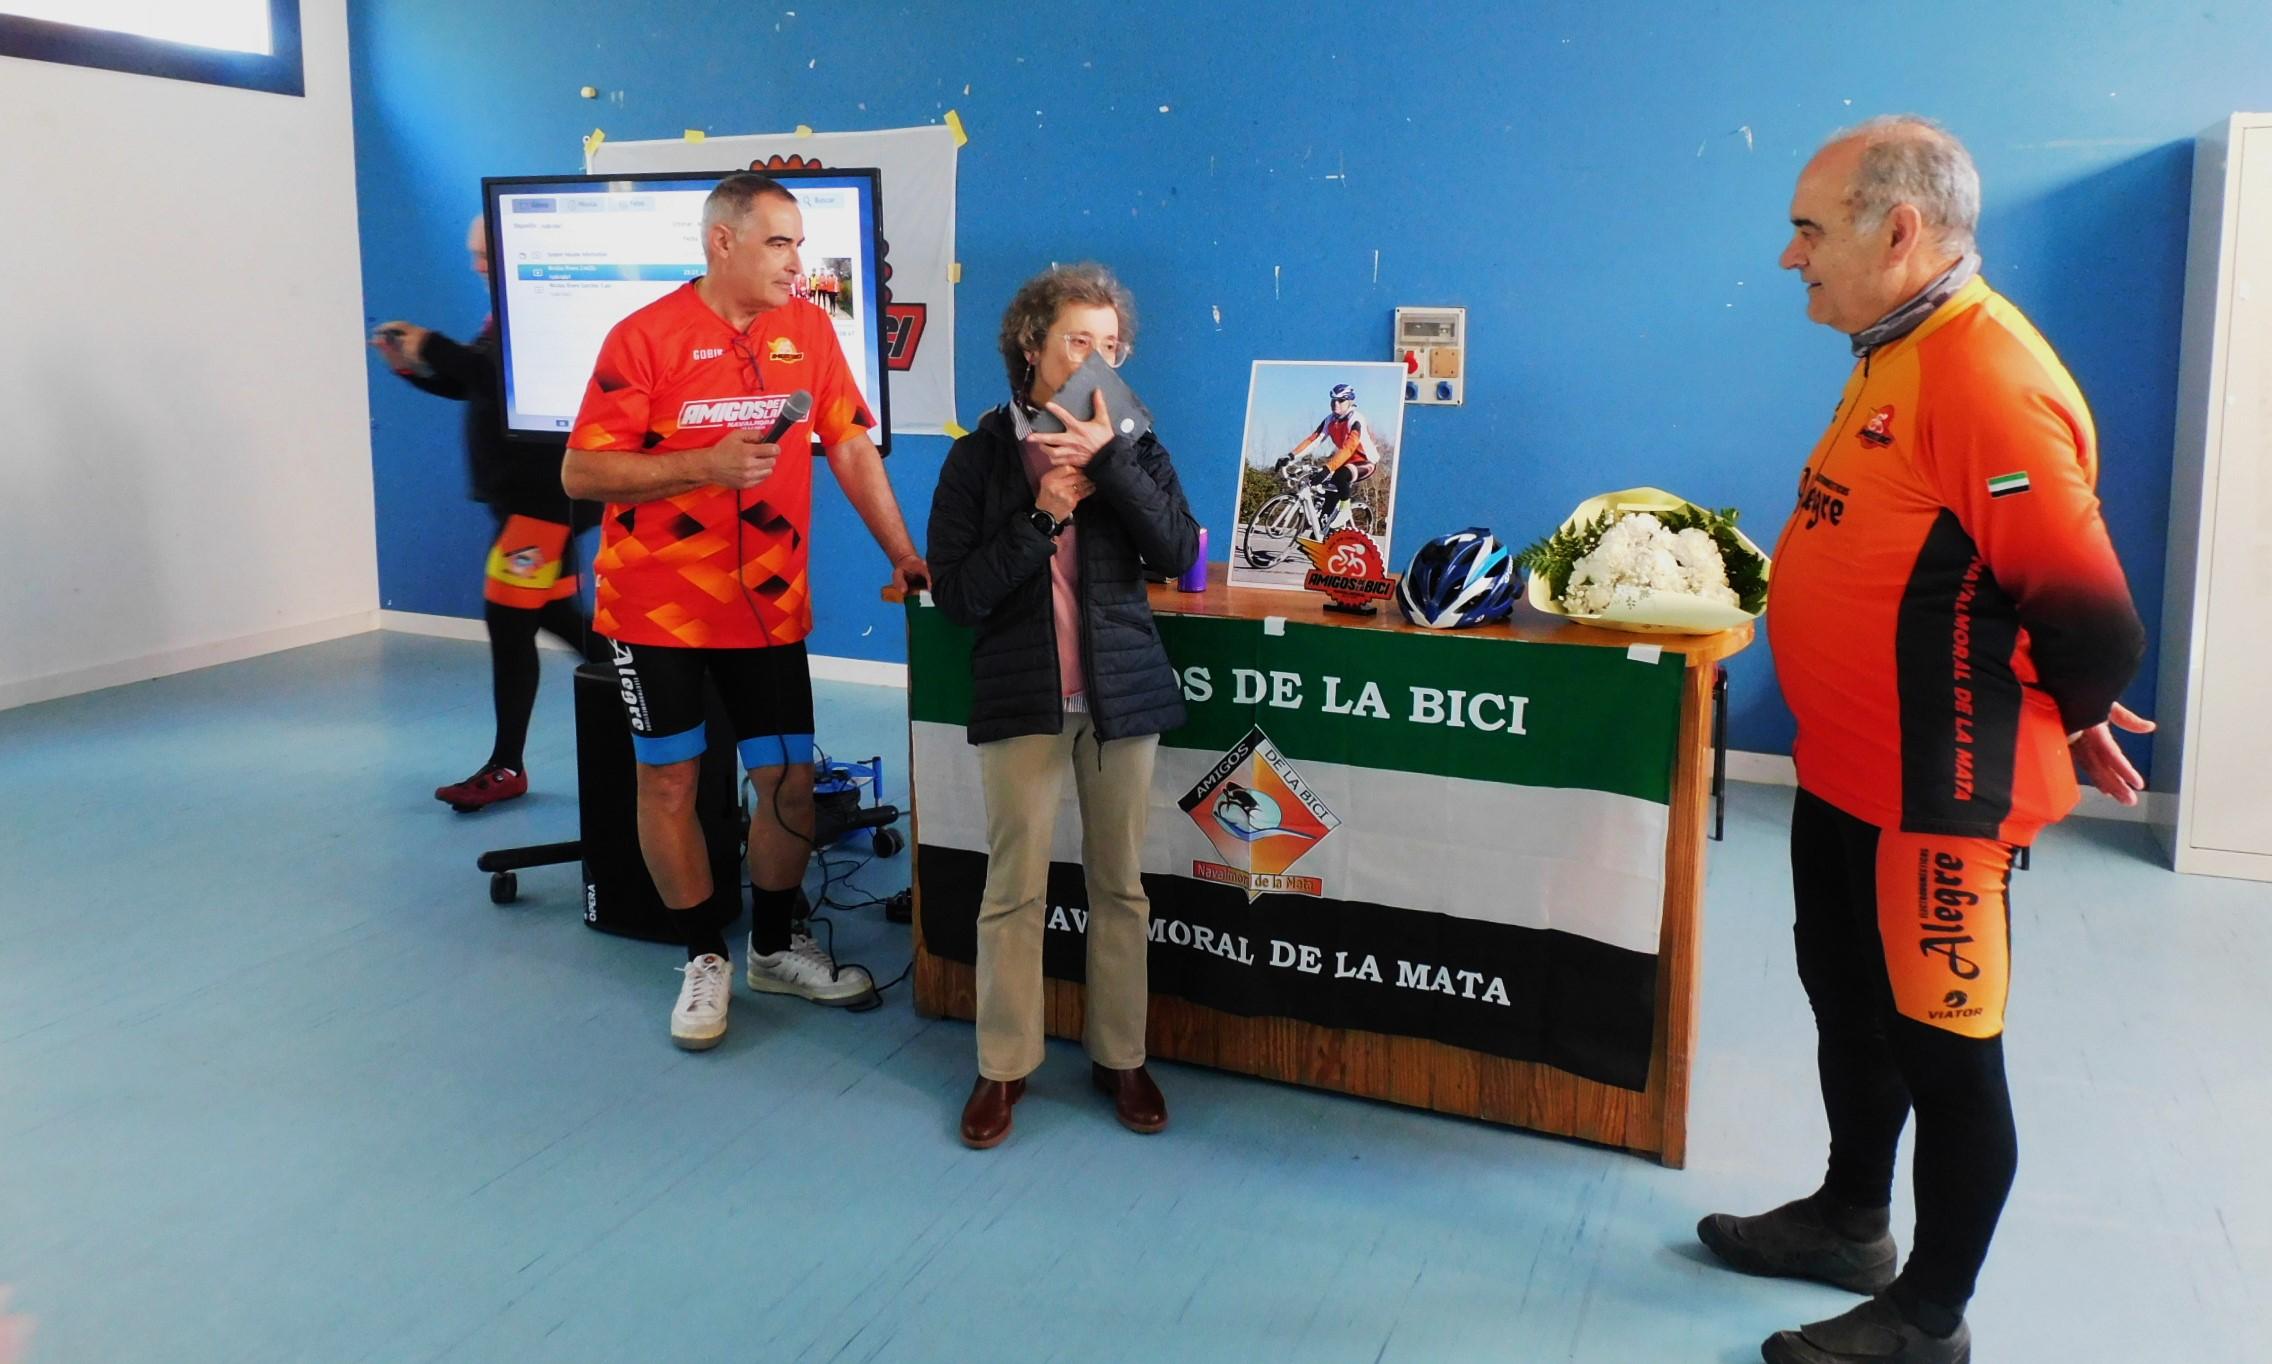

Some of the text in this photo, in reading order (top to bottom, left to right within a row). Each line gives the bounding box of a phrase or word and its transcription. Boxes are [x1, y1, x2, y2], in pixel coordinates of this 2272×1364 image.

[681, 401, 767, 424] AMIGOS
[1308, 574, 1358, 590] AMIGOS
[1364, 580, 1390, 595] BICI
[1232, 668, 1303, 709] DE
[1321, 676, 1390, 719] LA
[1408, 686, 1529, 735] BICI
[1954, 687, 1973, 715] DE
[1955, 716, 1974, 743] LA
[1196, 743, 1329, 820] AMIGOS DE LA BICI
[1953, 748, 1974, 801] MATA
[1254, 875, 1269, 888] de
[1272, 875, 1282, 889] la
[1919, 852, 1981, 980] Alegre
[1269, 939, 1322, 974] DE
[1334, 951, 1383, 983] LA
[1395, 960, 1511, 1006] MATA
[1928, 1007, 1983, 1020] VIATOR
